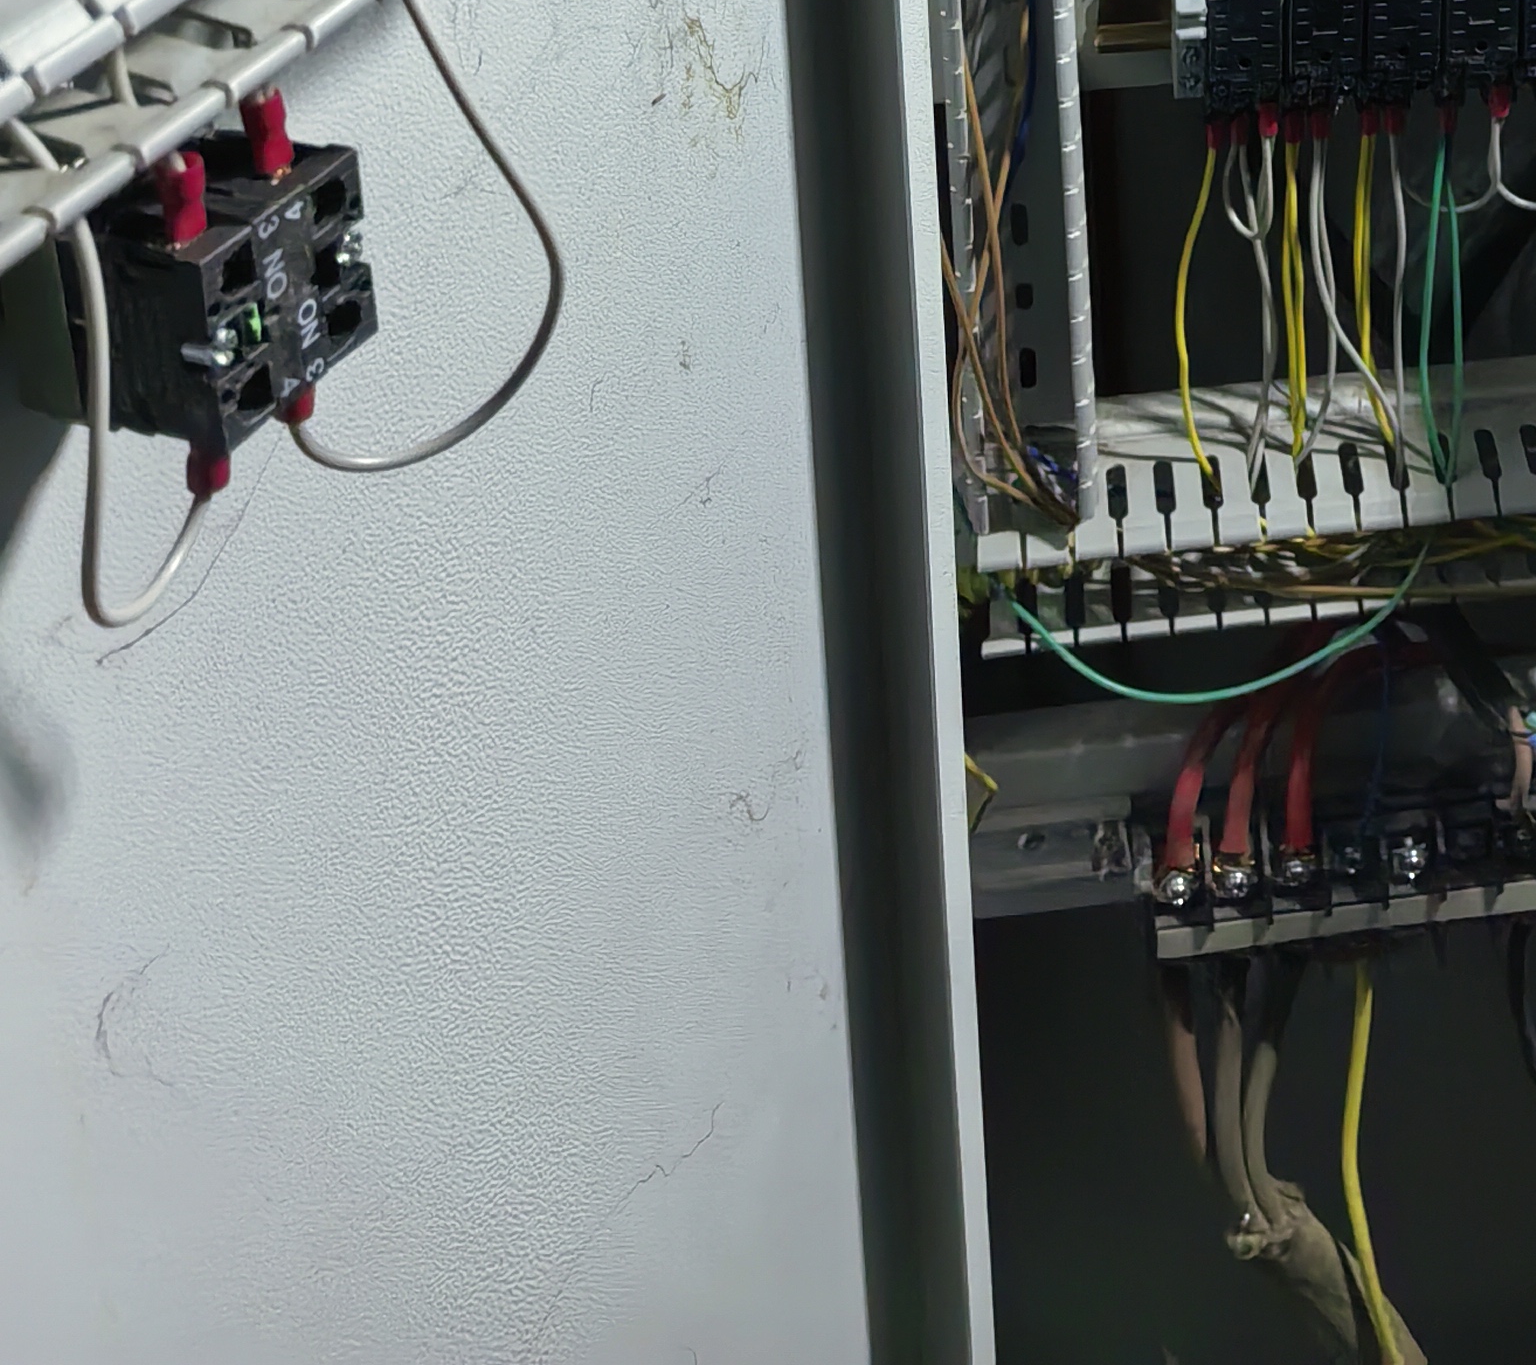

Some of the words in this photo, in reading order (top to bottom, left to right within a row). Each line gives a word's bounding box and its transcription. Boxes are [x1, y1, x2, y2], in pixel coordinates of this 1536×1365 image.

[284, 200, 305, 220] 4
[257, 215, 280, 240] 3
[262, 247, 288, 300] NO
[297, 298, 322, 350] NO
[306, 357, 325, 382] 3
